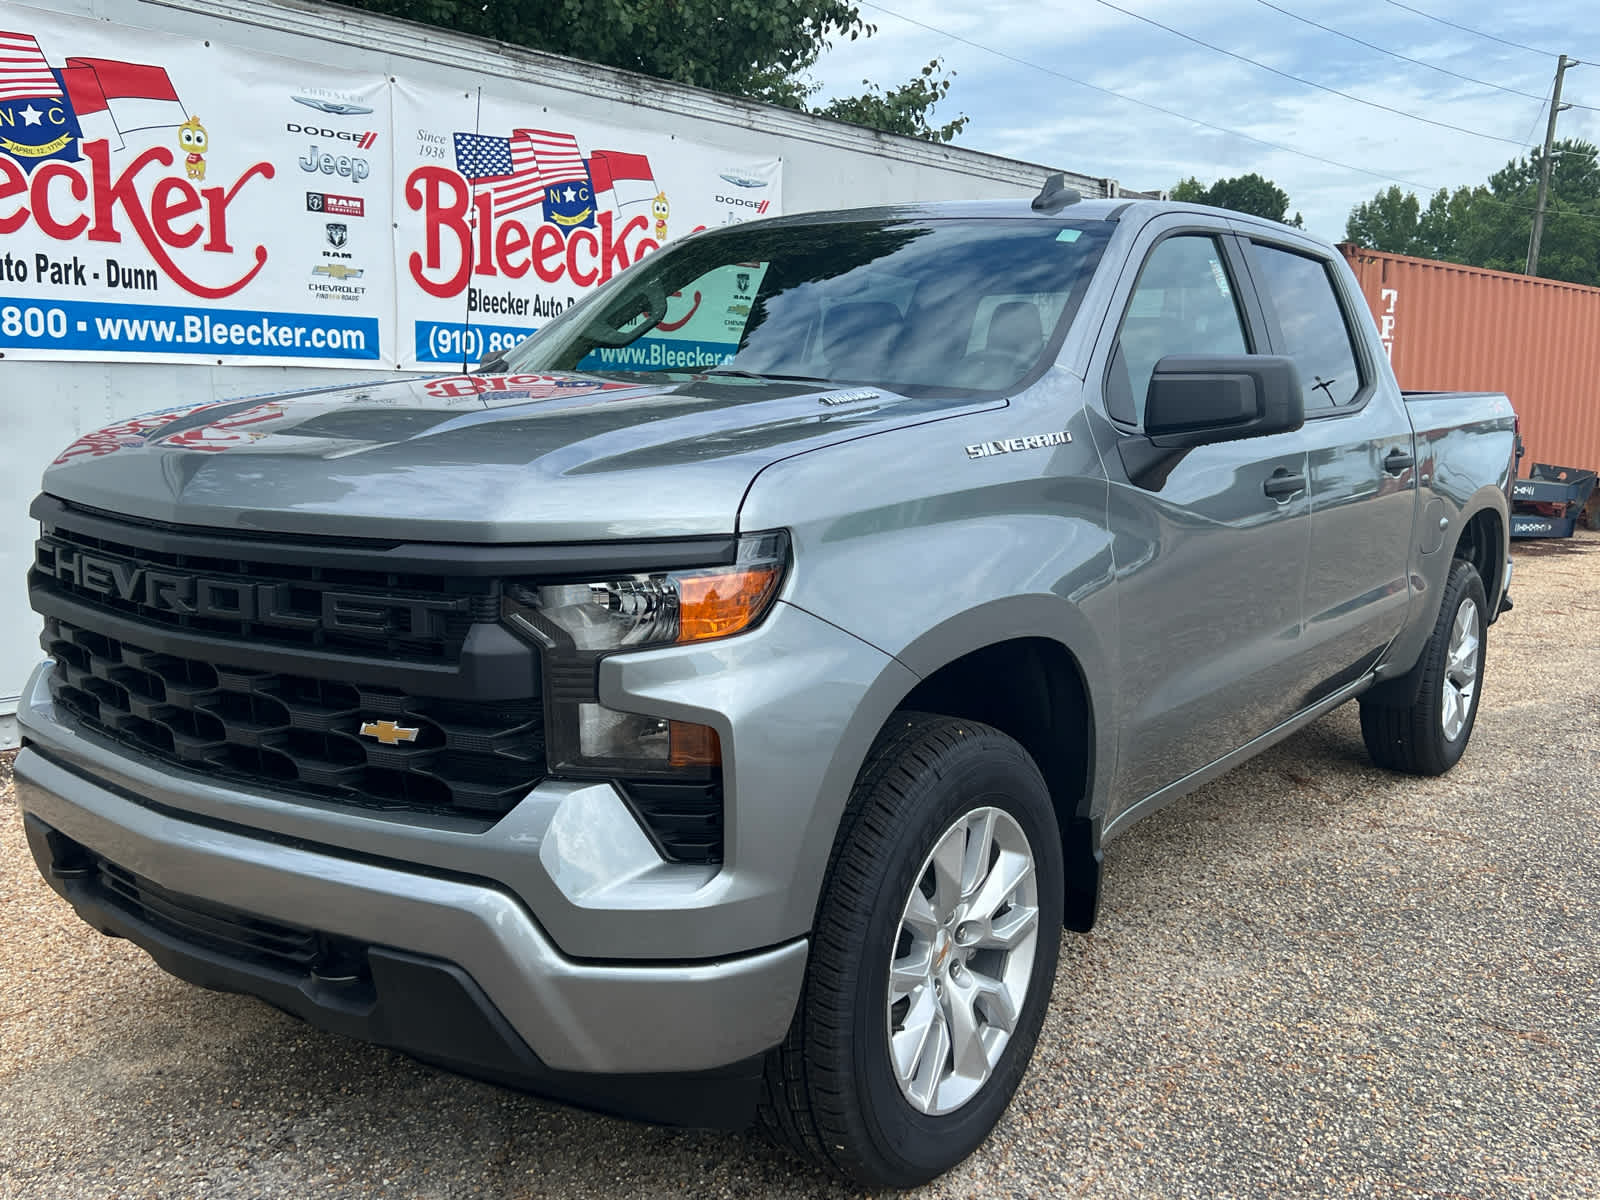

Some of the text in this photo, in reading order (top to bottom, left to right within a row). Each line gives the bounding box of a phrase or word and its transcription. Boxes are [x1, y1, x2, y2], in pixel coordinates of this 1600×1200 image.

[48, 107, 65, 125] C
[287, 123, 366, 142] DODGE
[417, 129, 447, 144] Since
[419, 145, 446, 159] 1938
[299, 145, 369, 183] Jeep
[327, 198, 361, 208] RAM
[550, 188, 589, 204] N C
[715, 195, 762, 208] DODGE
[322, 251, 352, 259] RAM
[35, 253, 87, 286] Park
[106, 259, 158, 291] Dunn
[308, 283, 367, 295] CHEVROLET
[469, 288, 530, 316] Bleecker
[533, 294, 563, 318] Auto
[95, 317, 366, 350] www.Bleecker.com
[428, 326, 484, 361] (910)
[966, 430, 1073, 460] SILVERADO
[35, 540, 470, 642] CHEVROLET
